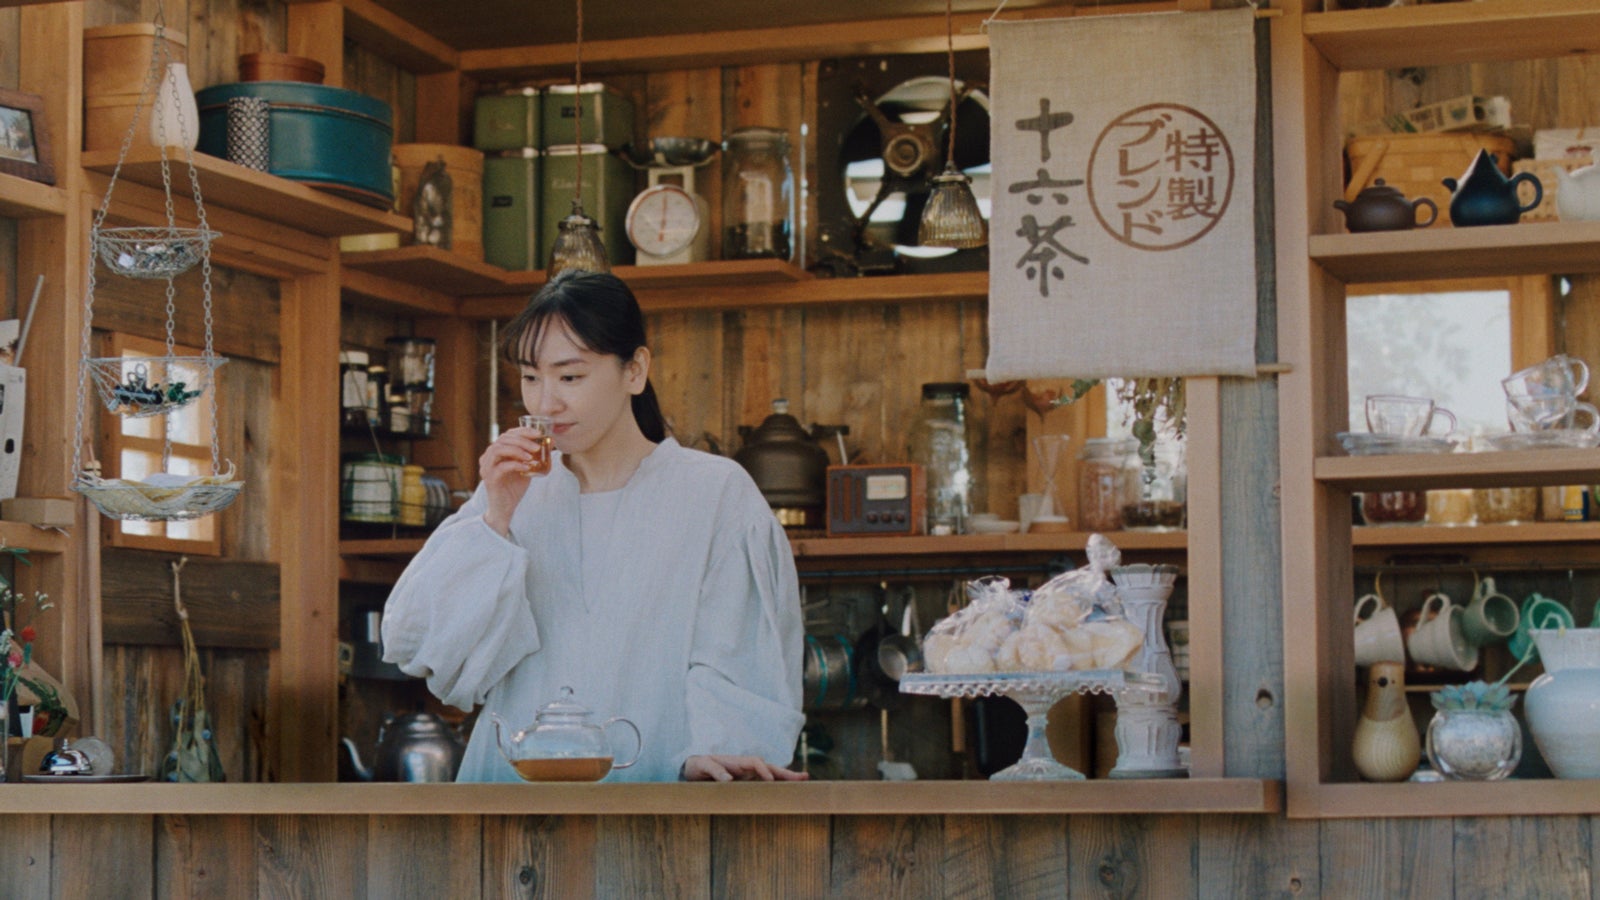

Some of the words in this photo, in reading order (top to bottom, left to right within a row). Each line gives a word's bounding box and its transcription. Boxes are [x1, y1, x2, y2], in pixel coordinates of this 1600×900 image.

[1008, 98, 1090, 297] 十六茶
[1114, 113, 1172, 242] ブレンド
[1165, 128, 1220, 219] 特製
